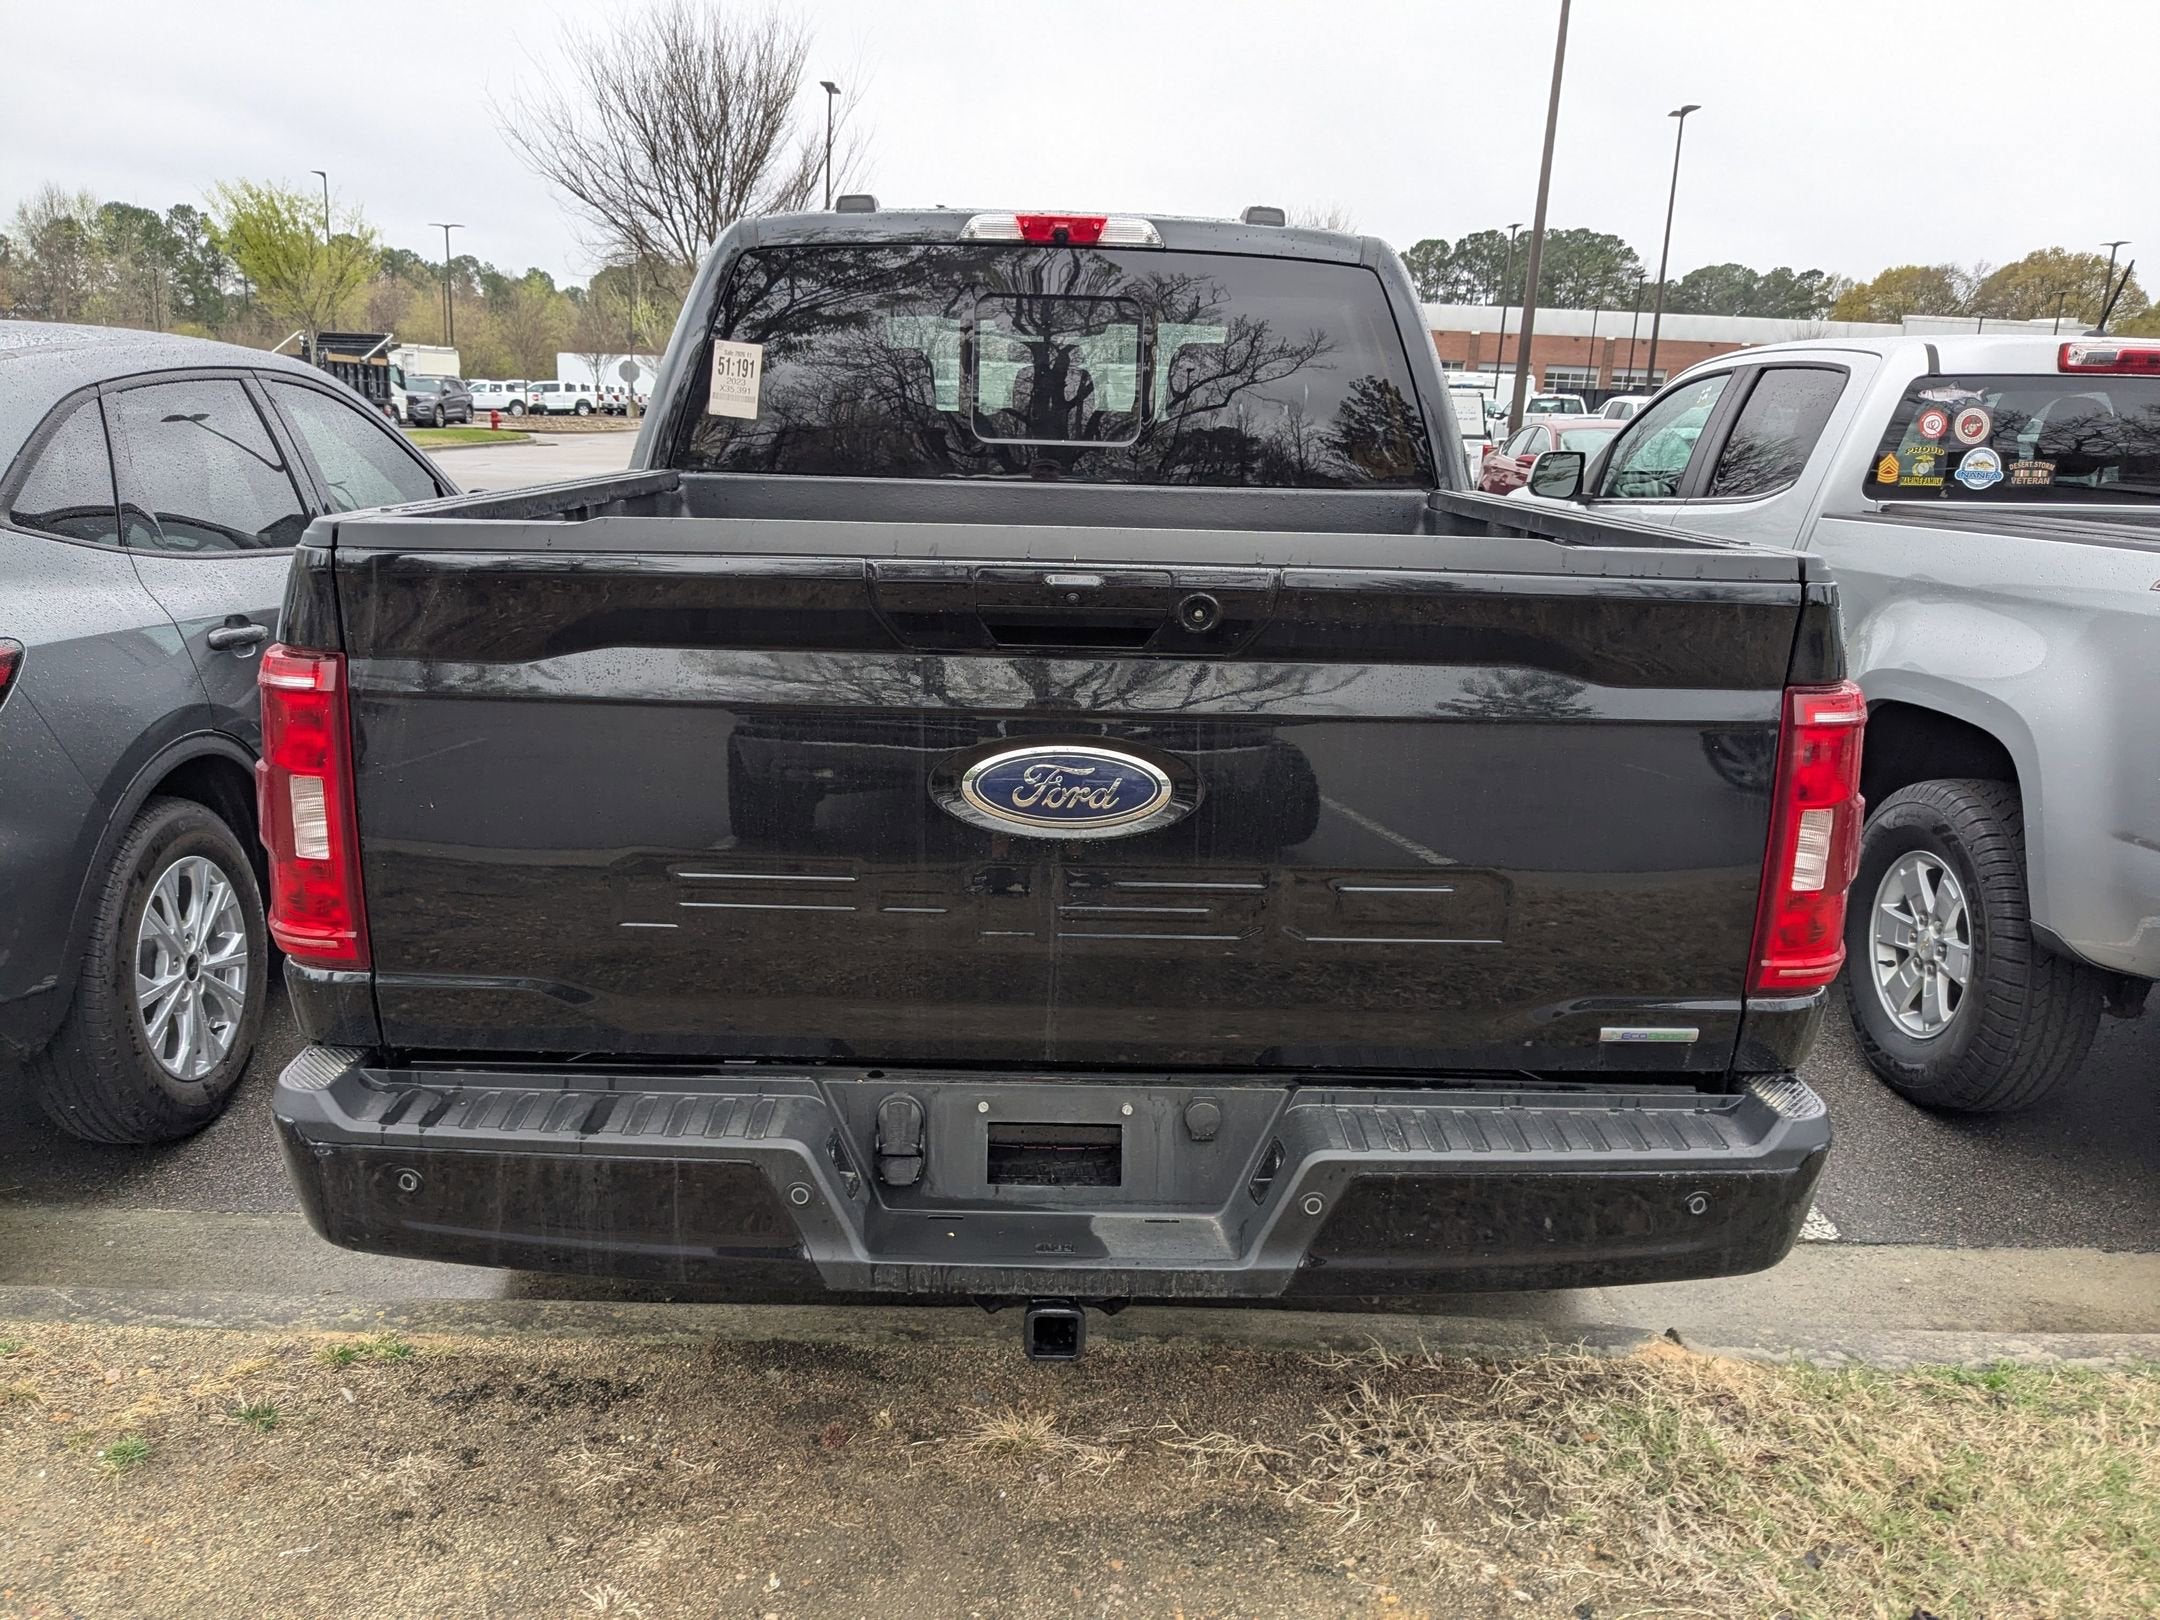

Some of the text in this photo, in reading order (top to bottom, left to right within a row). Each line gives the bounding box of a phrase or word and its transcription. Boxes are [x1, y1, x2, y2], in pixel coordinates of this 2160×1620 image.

[718, 356, 755, 379] 51:191
[726, 377, 747, 386] 2023
[1905, 446, 1945, 456] PROUD
[2009, 461, 2056, 471] DESERT STORM
[1958, 470, 1999, 481] NANFA
[2010, 477, 2050, 485] VETERAN
[1012, 763, 1123, 810] Ford
